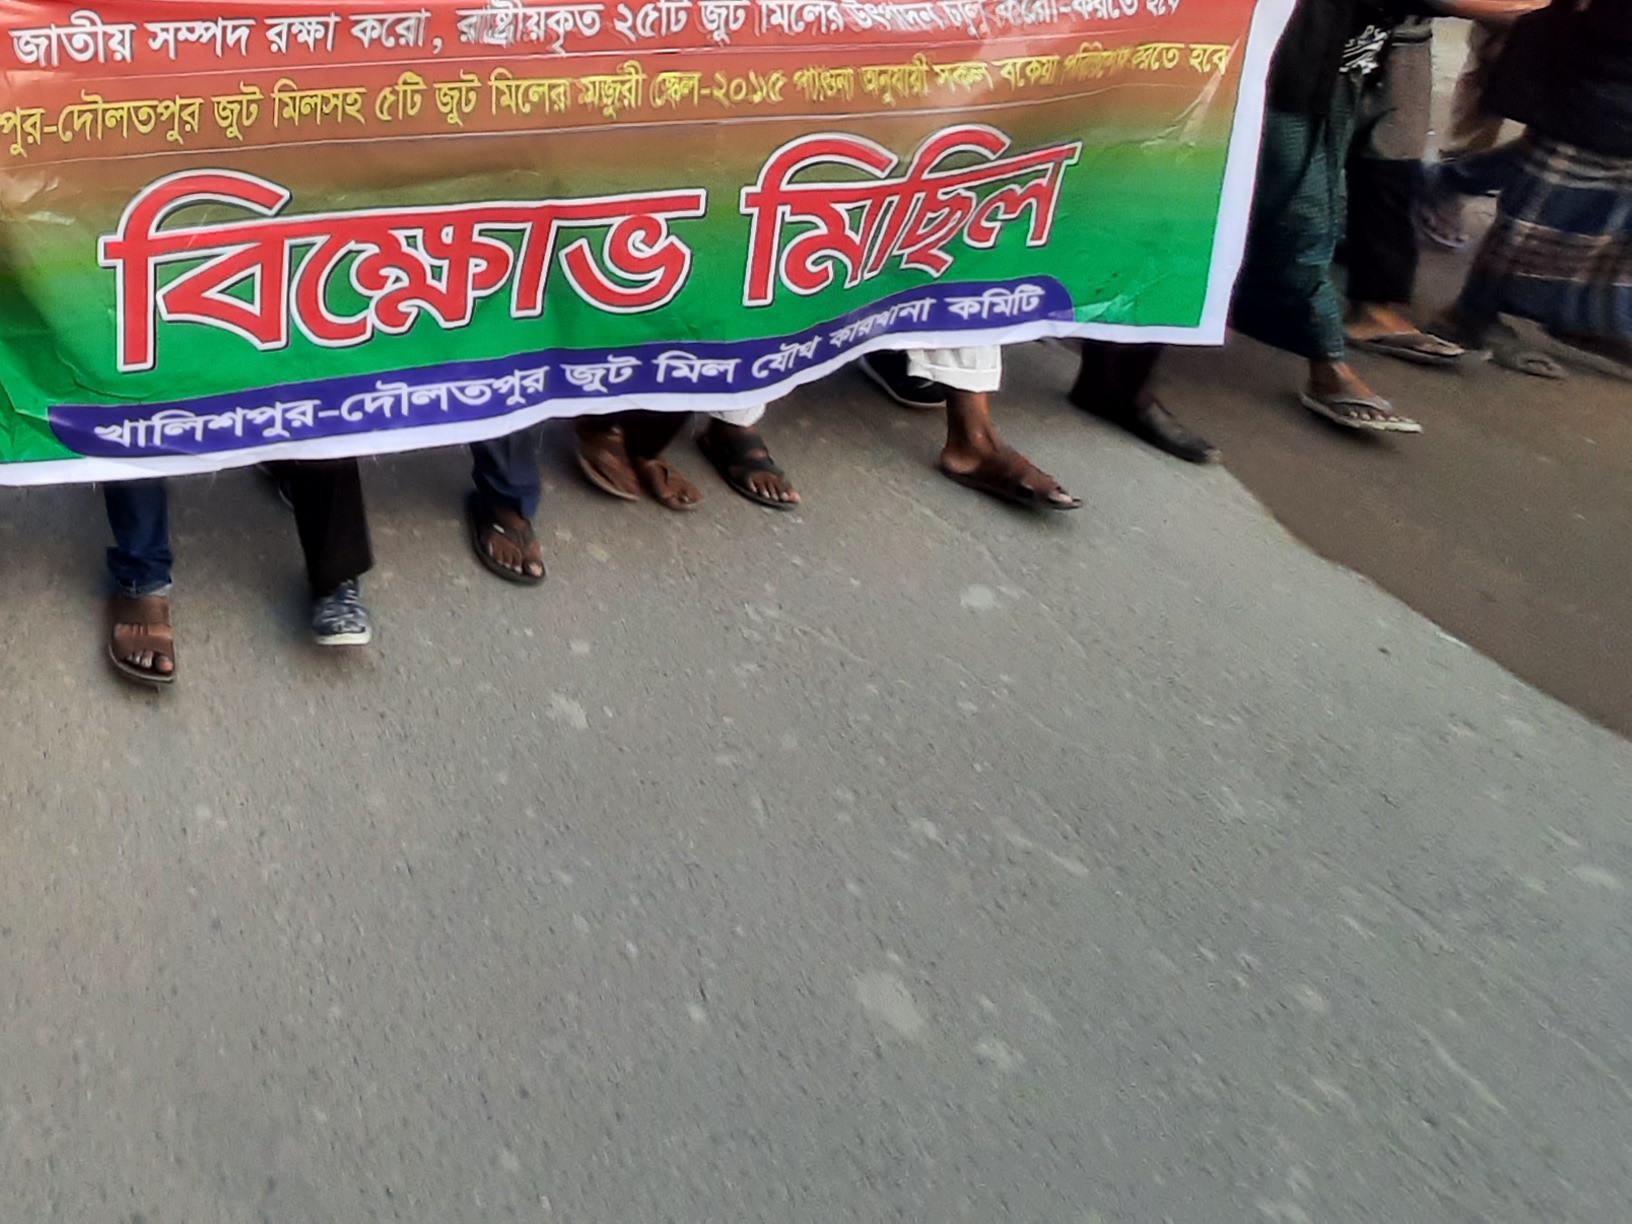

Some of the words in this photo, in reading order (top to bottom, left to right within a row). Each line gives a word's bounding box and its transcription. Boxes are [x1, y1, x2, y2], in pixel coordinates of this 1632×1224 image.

[9, 9, 136, 68] জাতীয়
[143, 16, 257, 61] সম্পদ
[264, 11, 341, 56] রক্ষা
[211, 80, 265, 141] জুট
[270, 77, 367, 128] মিলসহ
[375, 71, 427, 122] ৫টি
[433, 69, 482, 126] জুট
[489, 67, 571, 116] মিলের
[576, 59, 646, 119] মজুরী
[1189, 43, 1232, 77] হবে
[98, 167, 707, 373] বিক্ষোভ
[741, 123, 1082, 307] মিছিল
[94, 364, 550, 449] খালিশপুর-দৌলতপুর
[559, 352, 643, 394] জুট
[651, 348, 742, 385] মিল
[751, 333, 822, 381] যৌথ
[829, 297, 936, 350] কারখানা
[943, 283, 1047, 321] কমিটি
